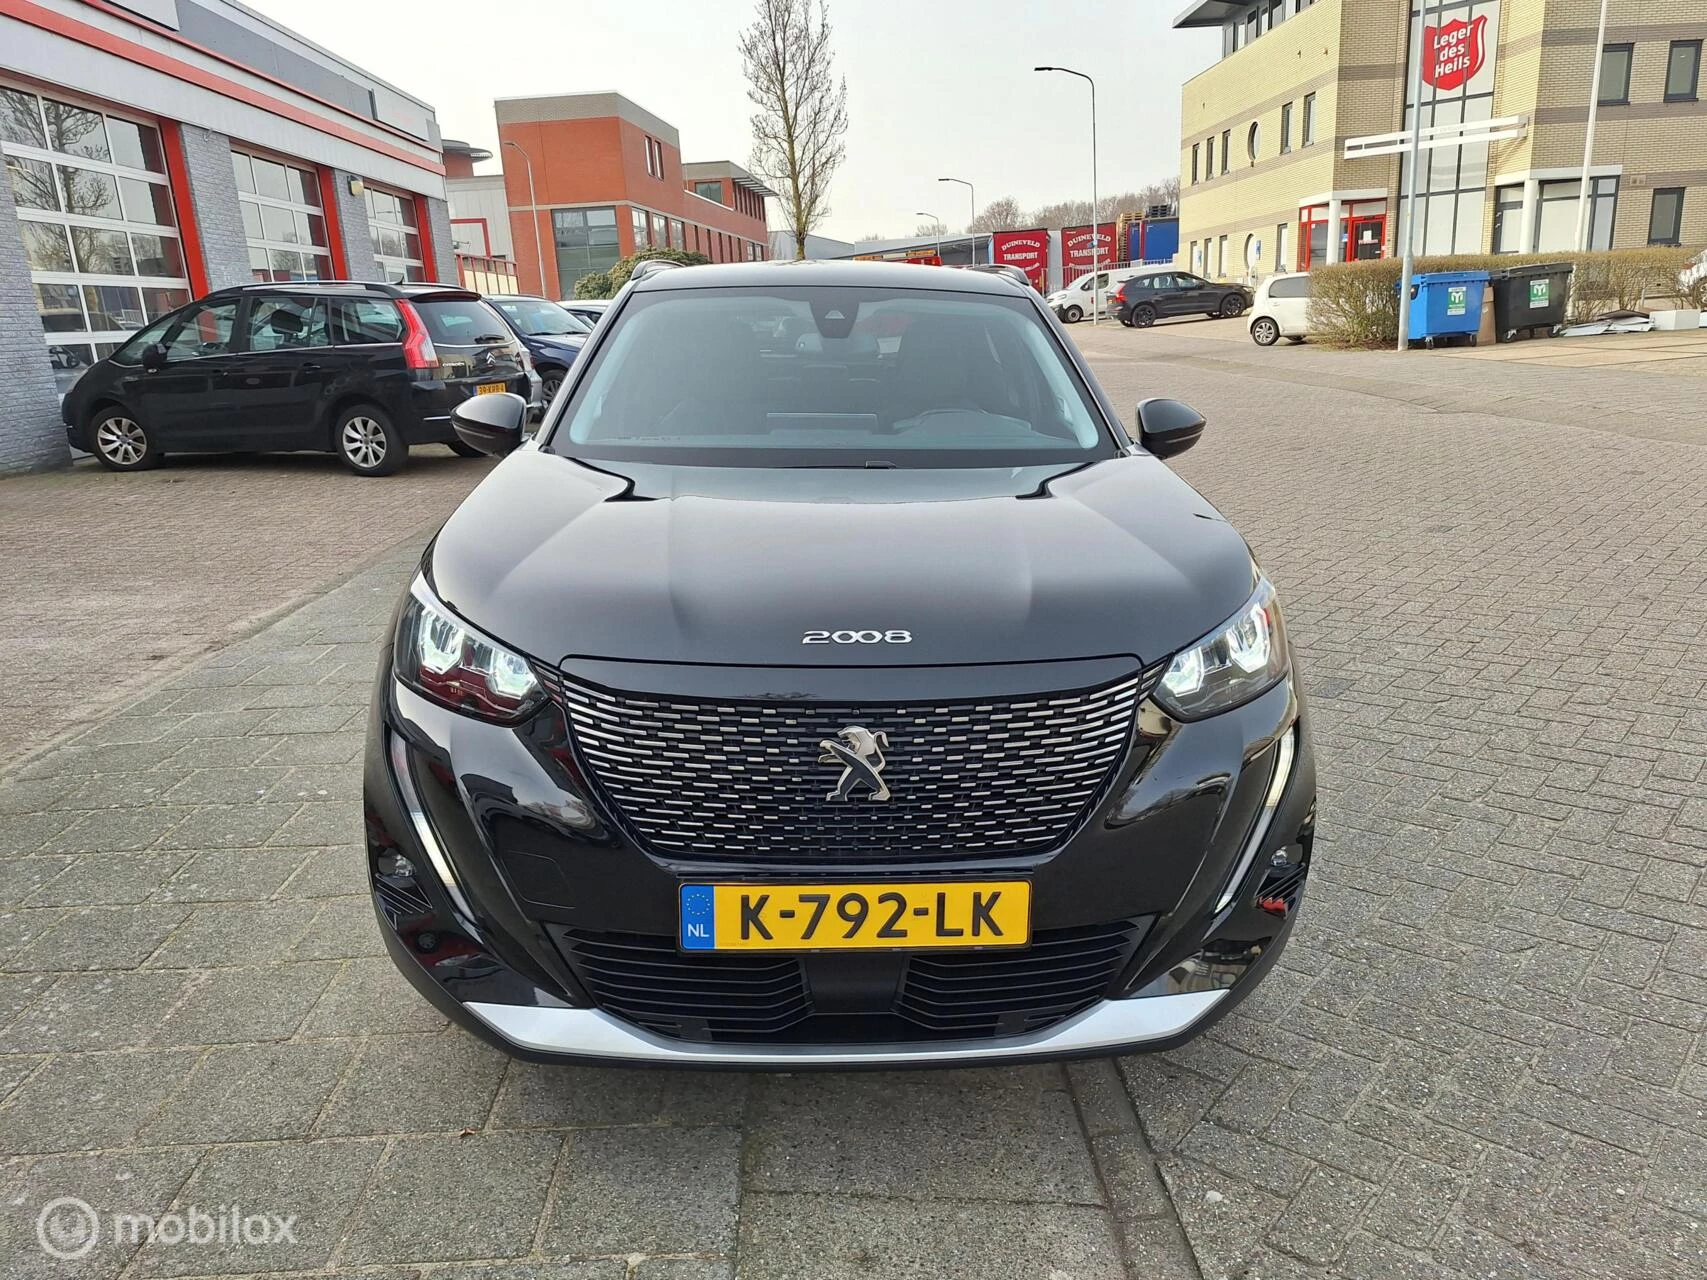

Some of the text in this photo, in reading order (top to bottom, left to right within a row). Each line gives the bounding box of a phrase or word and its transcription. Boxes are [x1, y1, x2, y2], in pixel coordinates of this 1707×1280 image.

[1433, 24, 1474, 49] Leger
[1439, 42, 1465, 62] des
[1434, 55, 1470, 78] Heils
[1001, 239, 1041, 251] DUINEVELD
[1003, 251, 1038, 261] TRANSPORT
[802, 630, 912, 644] 2008
[740, 890, 1004, 940] K-792-LK
[687, 923, 710, 938] NL
